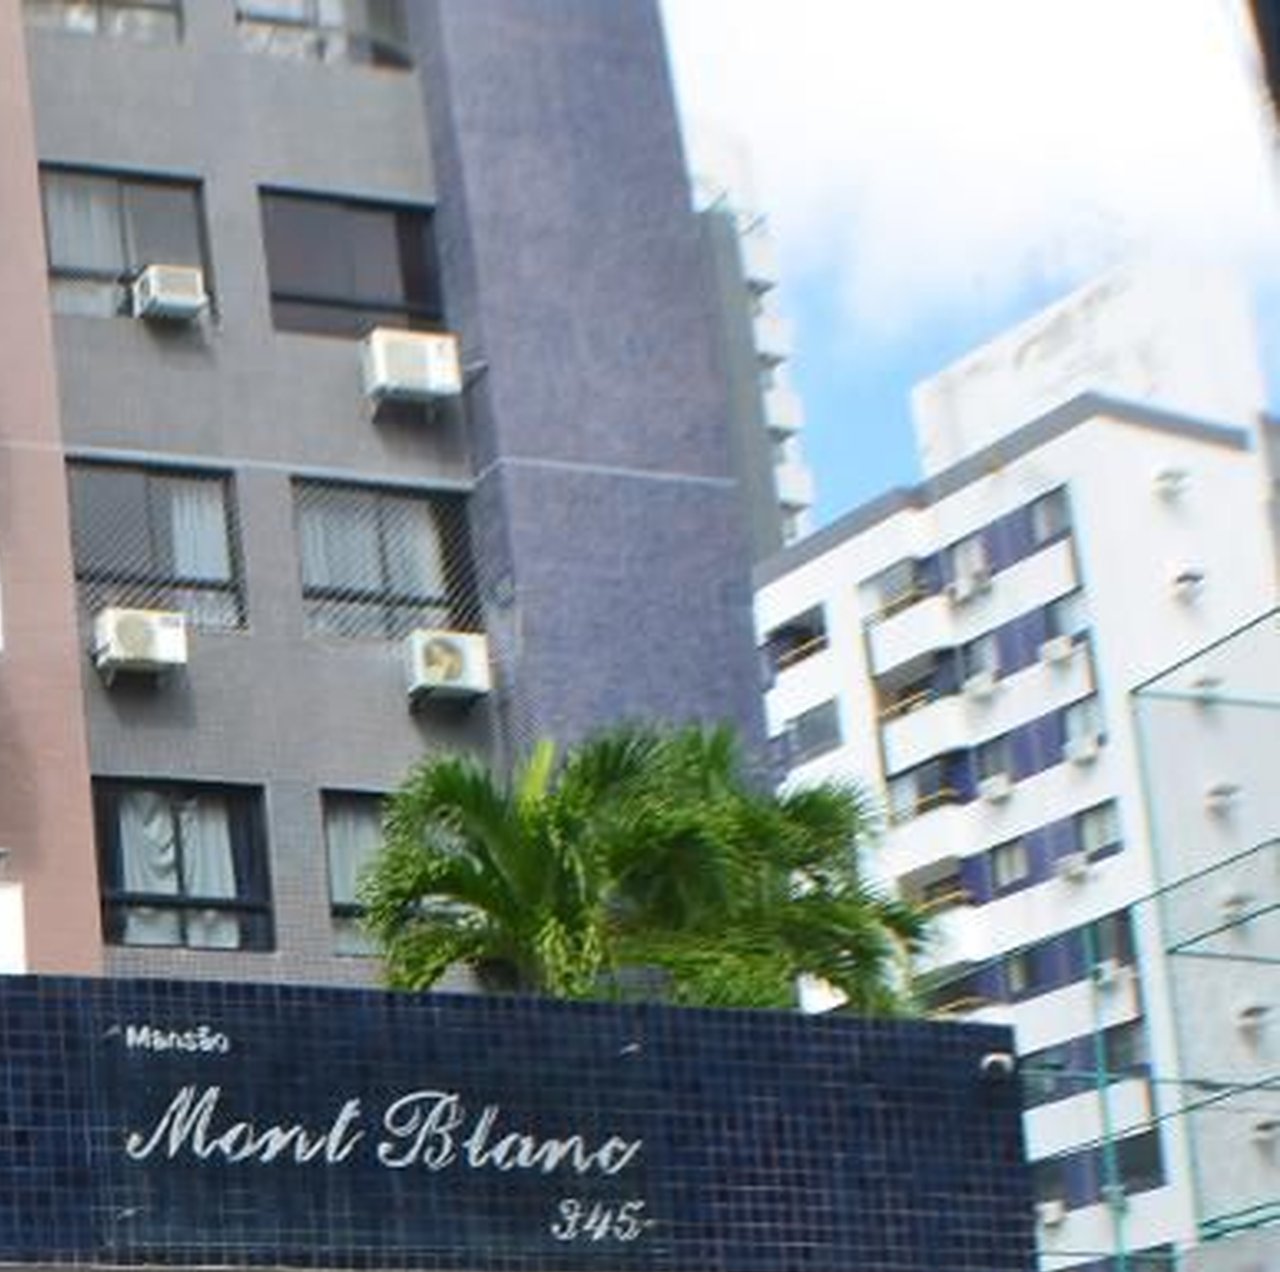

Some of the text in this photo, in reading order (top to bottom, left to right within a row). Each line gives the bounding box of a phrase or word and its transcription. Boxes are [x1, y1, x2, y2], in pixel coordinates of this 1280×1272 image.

[125, 1024, 229, 1054] Mansão
[125, 1085, 642, 1175] Mont Blanc
[550, 1199, 646, 1241] 345
